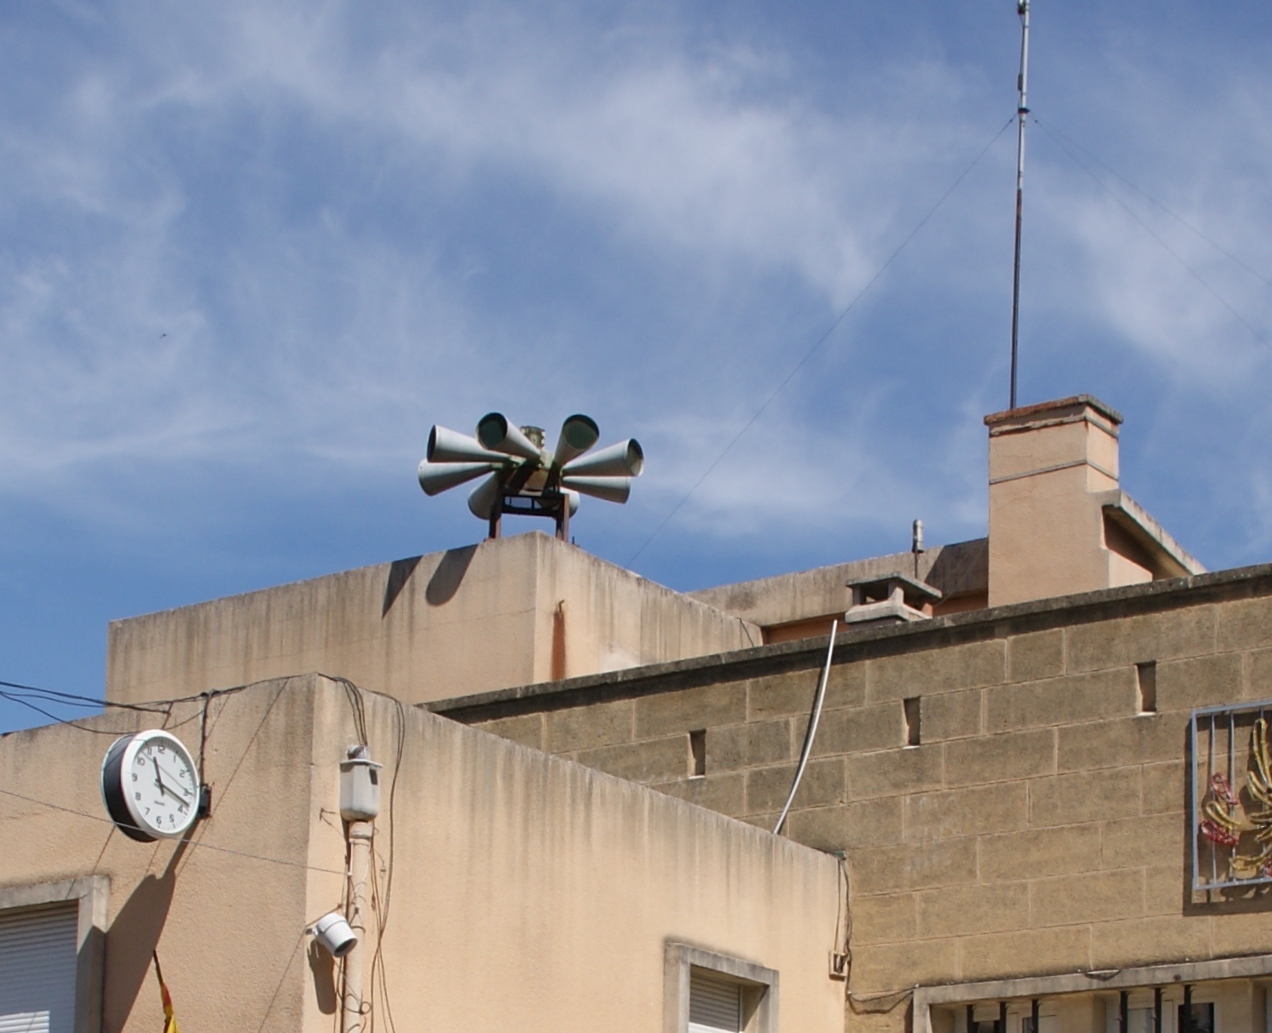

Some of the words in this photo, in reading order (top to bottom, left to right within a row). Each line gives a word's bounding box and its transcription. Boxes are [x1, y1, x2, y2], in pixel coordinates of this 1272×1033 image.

[158, 745, 165, 754] 12
[137, 757, 145, 766] 10
[132, 773, 138, 782] 9
[179, 769, 185, 778] 2
[135, 792, 141, 801] 8
[145, 807, 150, 815] 7
[156, 816, 162, 824] 6
[169, 814, 175, 823] 5
